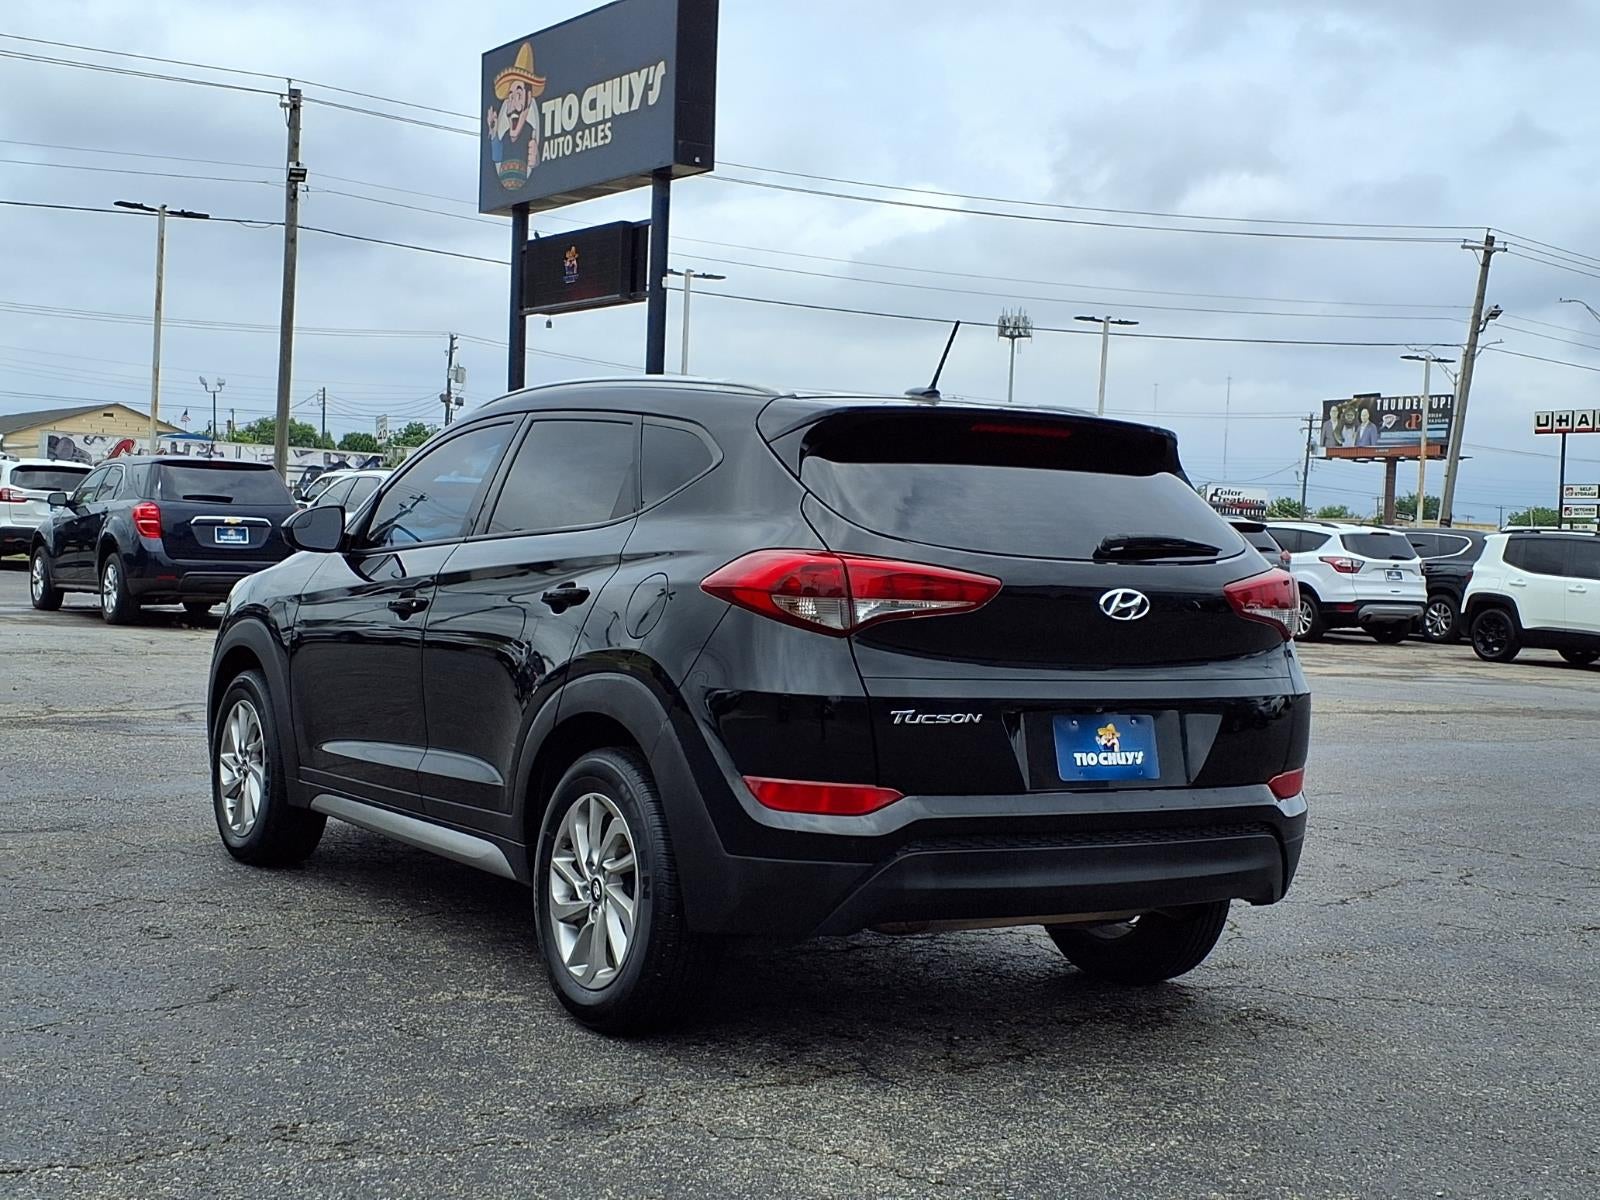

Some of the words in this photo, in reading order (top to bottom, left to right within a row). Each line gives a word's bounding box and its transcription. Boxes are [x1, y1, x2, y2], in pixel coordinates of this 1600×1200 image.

[541, 93, 580, 137] TIO
[581, 60, 666, 124] CHUY'S
[541, 134, 573, 162] AUTO
[575, 122, 612, 153] SALES
[1432, 397, 1452, 409] UP!
[1536, 413, 1600, 427] UHA
[377, 429, 387, 440] 40
[1214, 487, 1242, 497] Color
[1208, 493, 1265, 505] Creations
[1073, 751, 1097, 766] TIO
[1098, 750, 1144, 766] CHUY'S
